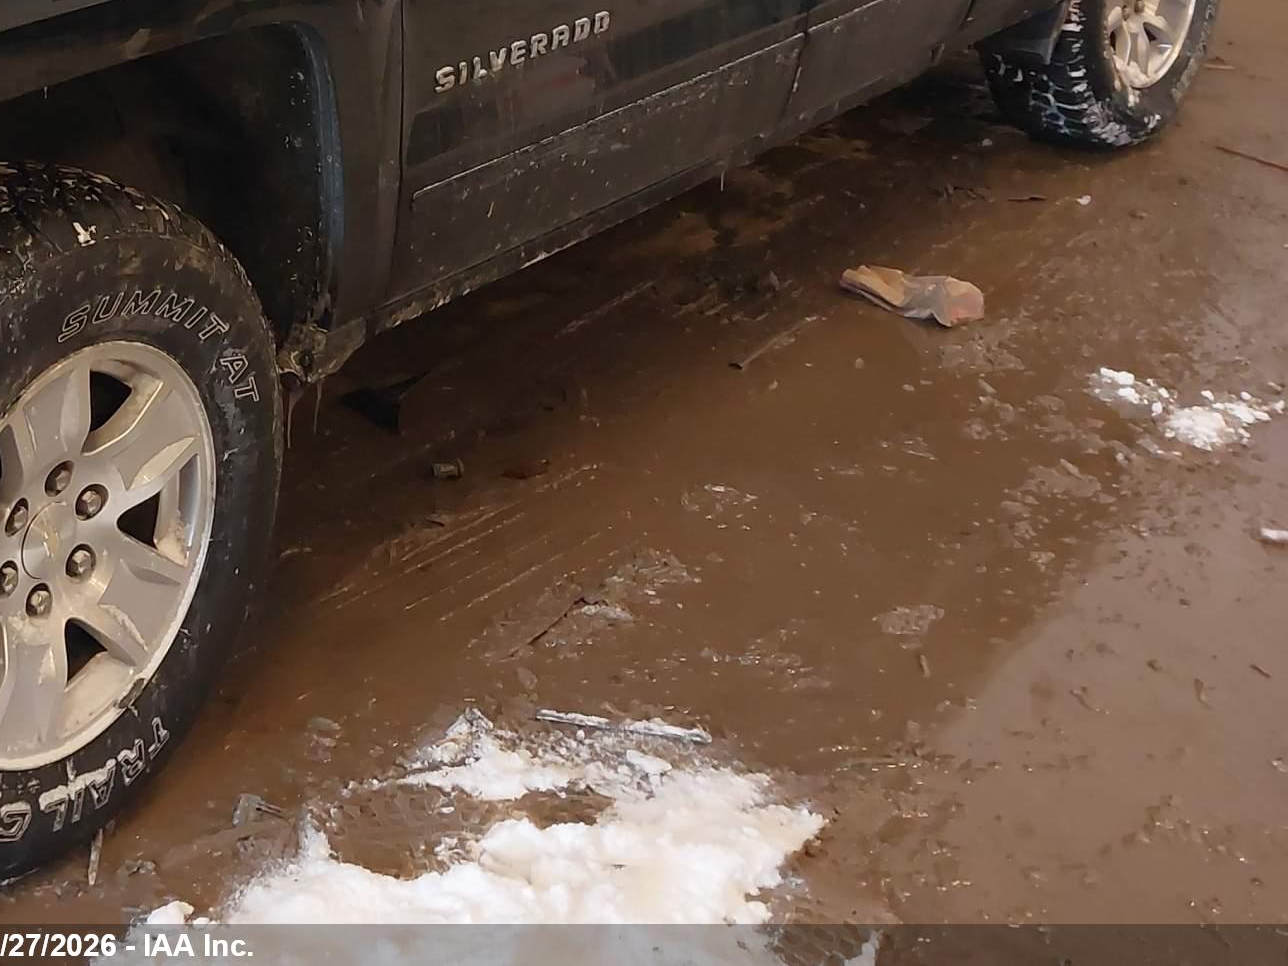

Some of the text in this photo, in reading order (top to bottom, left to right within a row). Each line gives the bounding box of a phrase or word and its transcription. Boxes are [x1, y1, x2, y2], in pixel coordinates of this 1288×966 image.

[434, 10, 611, 94] SILVERADO
[57, 289, 260, 403] SUMMIT AT
[39, 716, 170, 833] TRAIL
